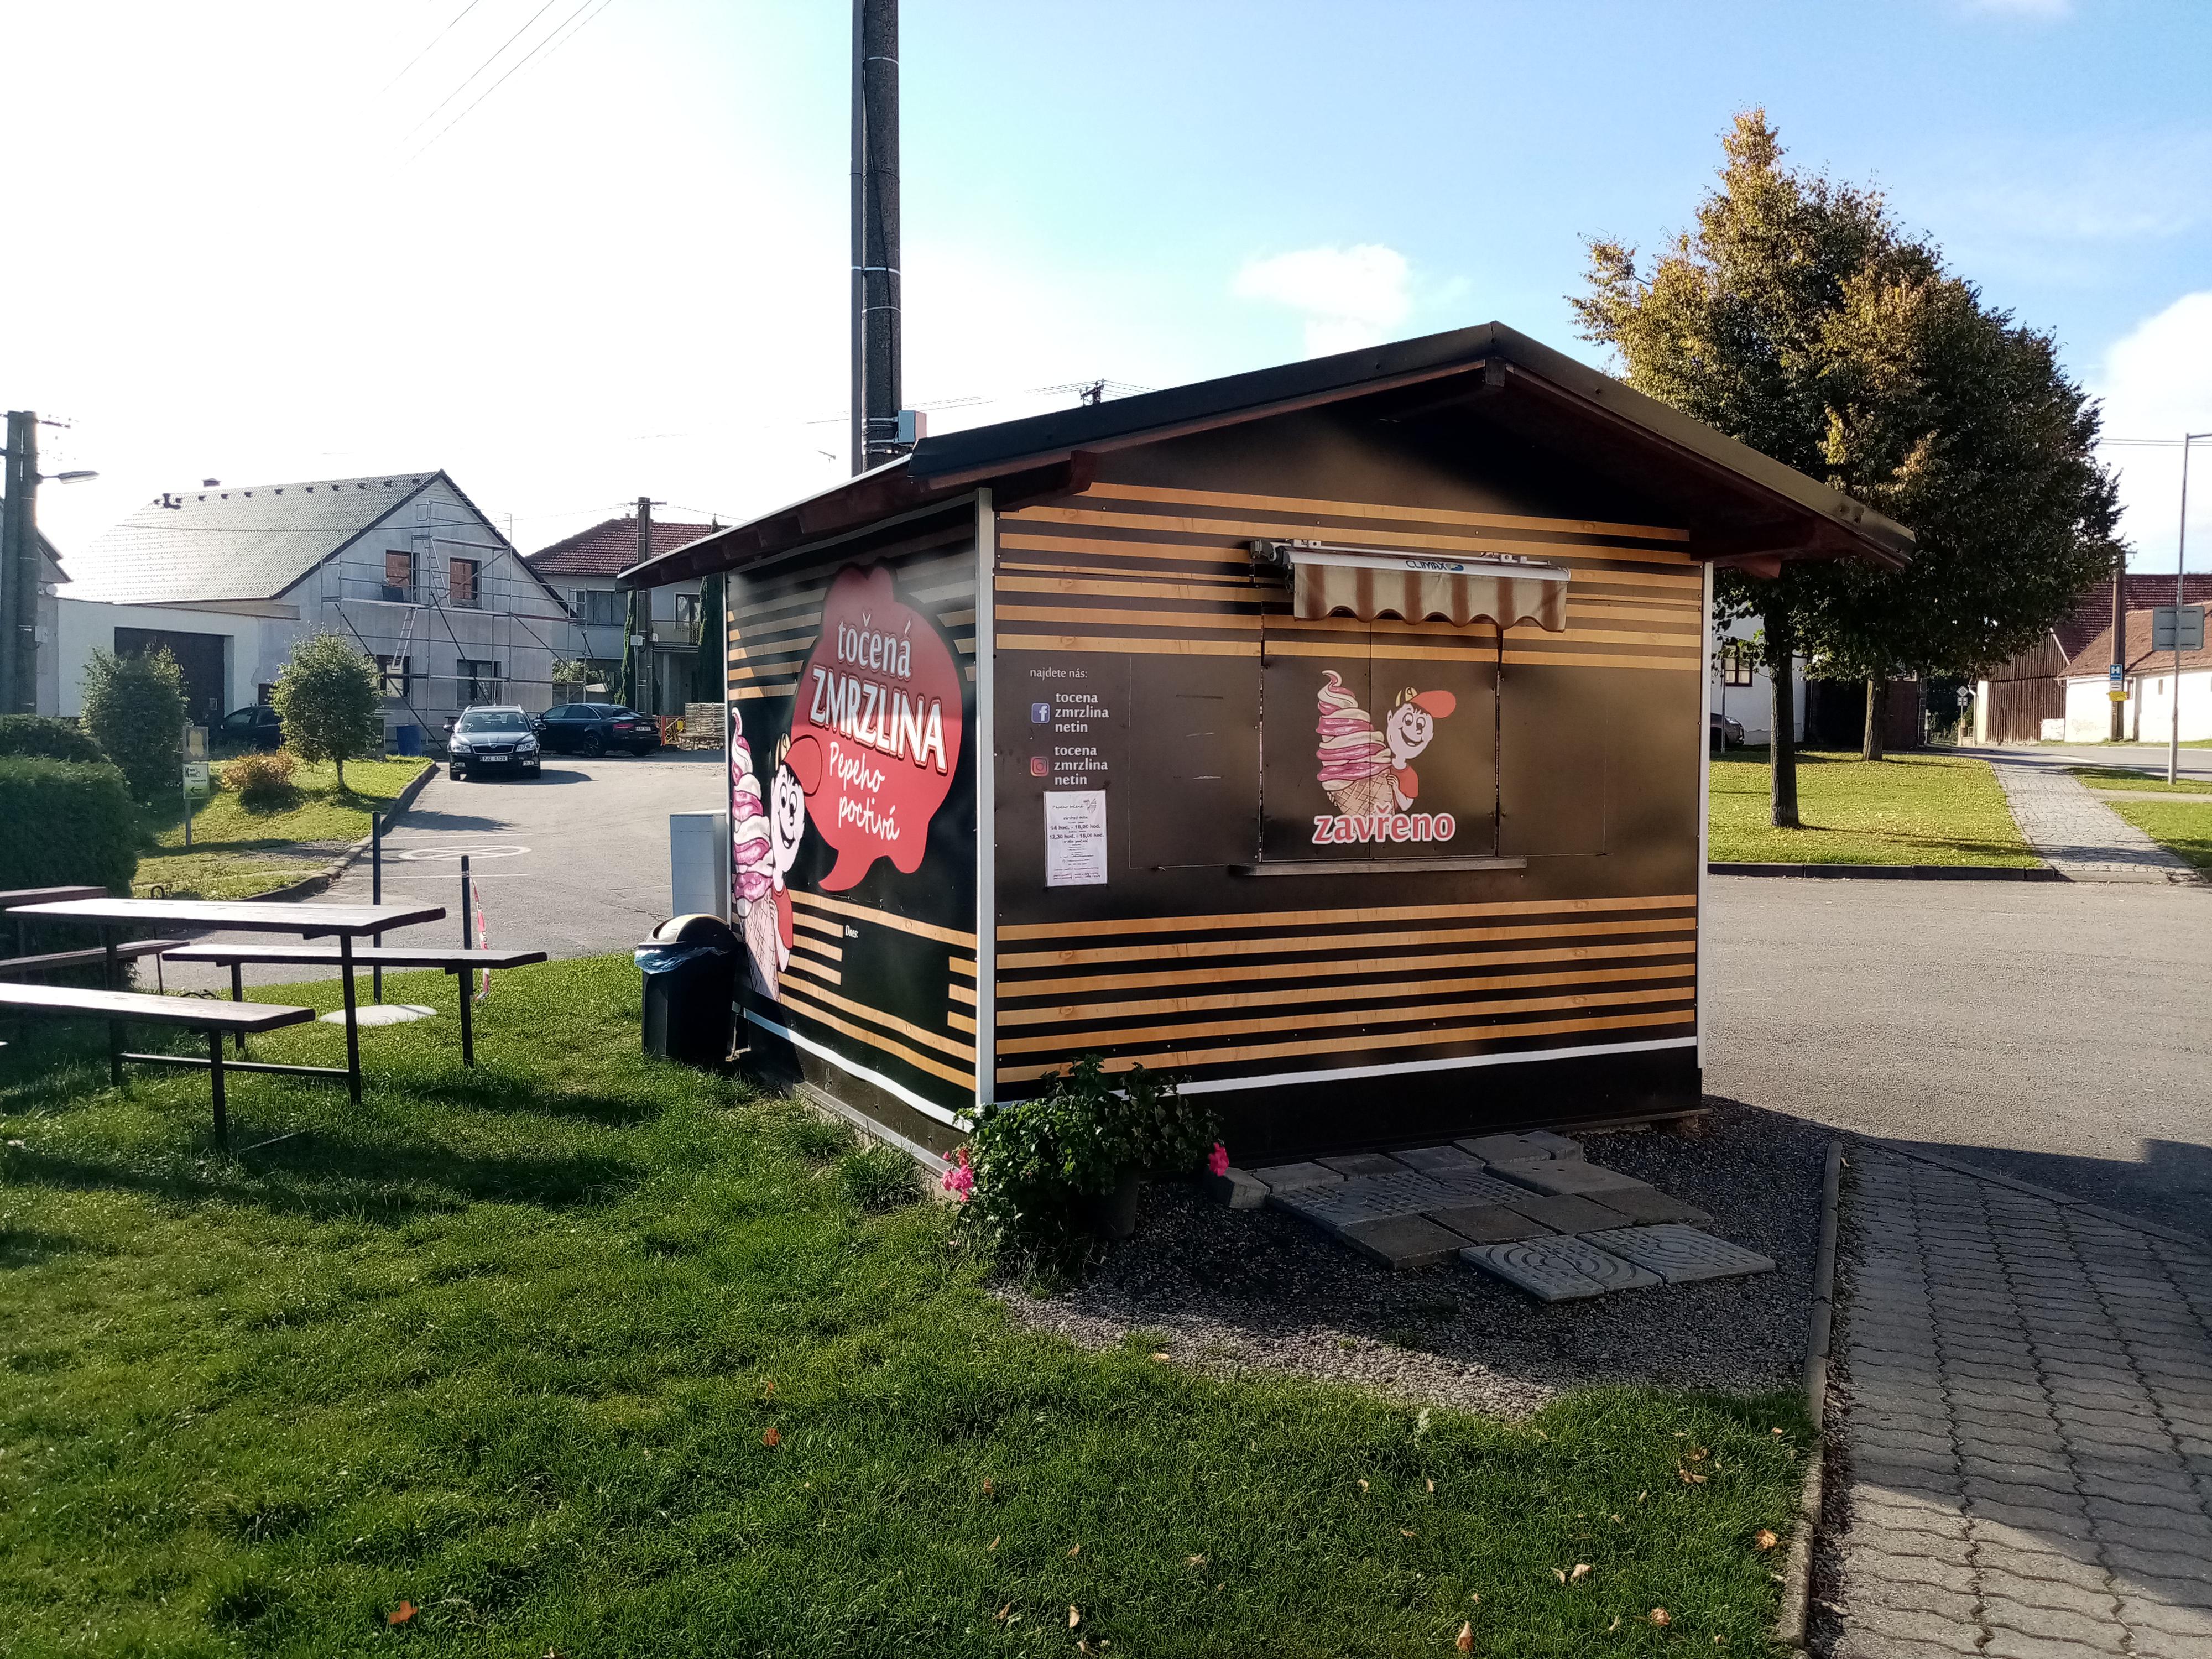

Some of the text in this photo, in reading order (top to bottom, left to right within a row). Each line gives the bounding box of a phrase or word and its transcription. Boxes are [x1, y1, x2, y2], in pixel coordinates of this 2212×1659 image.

[1405, 560, 1447, 571] CLIMAX
[837, 613, 912, 680] točená
[1030, 667, 1088, 681] najdete nás:
[1056, 693, 1098, 703] tocena
[1055, 705, 1109, 718] zmrzlina
[810, 666, 947, 773] ZMRZLINA
[1055, 721, 1088, 733] netin
[1055, 747, 1097, 756] tocena
[830, 742, 885, 793] Pepeho
[1054, 758, 1109, 770] zmrzlina
[1055, 773, 1087, 785] netin
[838, 796, 900, 841] poctivá
[1313, 802, 1455, 843] zavřeno
[846, 925, 859, 938] Dnes:
